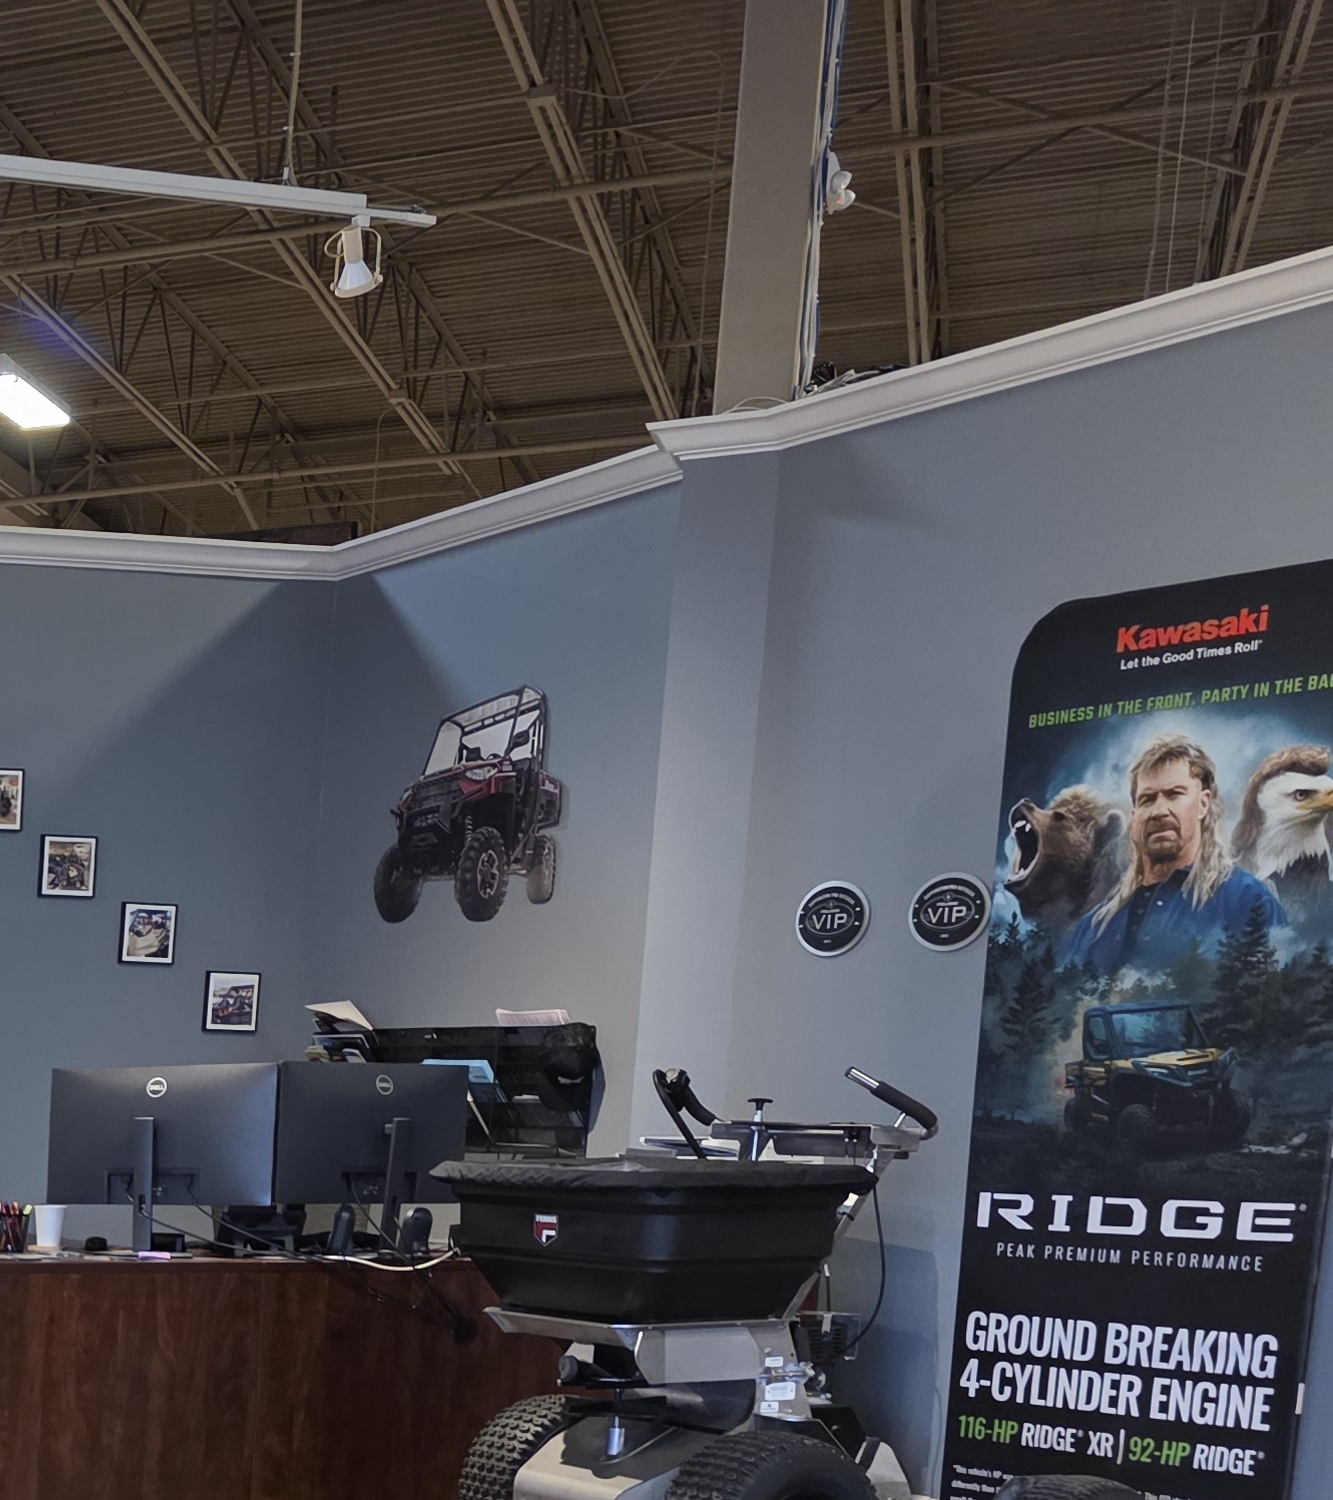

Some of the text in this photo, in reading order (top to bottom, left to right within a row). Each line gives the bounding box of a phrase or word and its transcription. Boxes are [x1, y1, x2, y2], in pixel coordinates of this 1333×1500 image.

[1116, 604, 1270, 653] Kawasaki
[1120, 657, 1139, 670] Let
[1141, 655, 1161, 667] the
[1162, 648, 1194, 663] Good
[1196, 645, 1232, 659] Times
[1028, 706, 1095, 728] BUSINESS
[1098, 703, 1113, 718] IN
[1117, 698, 1143, 715] THE
[1146, 692, 1196, 711] FRONT.
[1201, 684, 1250, 704] PARTY
[1253, 681, 1270, 698] IN
[1275, 677, 1304, 695] THE
[812, 913, 848, 930] VIP
[927, 905, 967, 924] VIP
[149, 1084, 165, 1092] DELL
[976, 1191, 1296, 1242] RIDGE
[996, 1242, 1264, 1272] PEAK PREMIUM PERFORMANCE
[965, 1311, 1279, 1379] GROUND BREAKING
[959, 1358, 1275, 1432] 4-CYLINDER ENGINE
[958, 1414, 1257, 1477] 116-HP RIDGE XR 92-HP RIDGE
